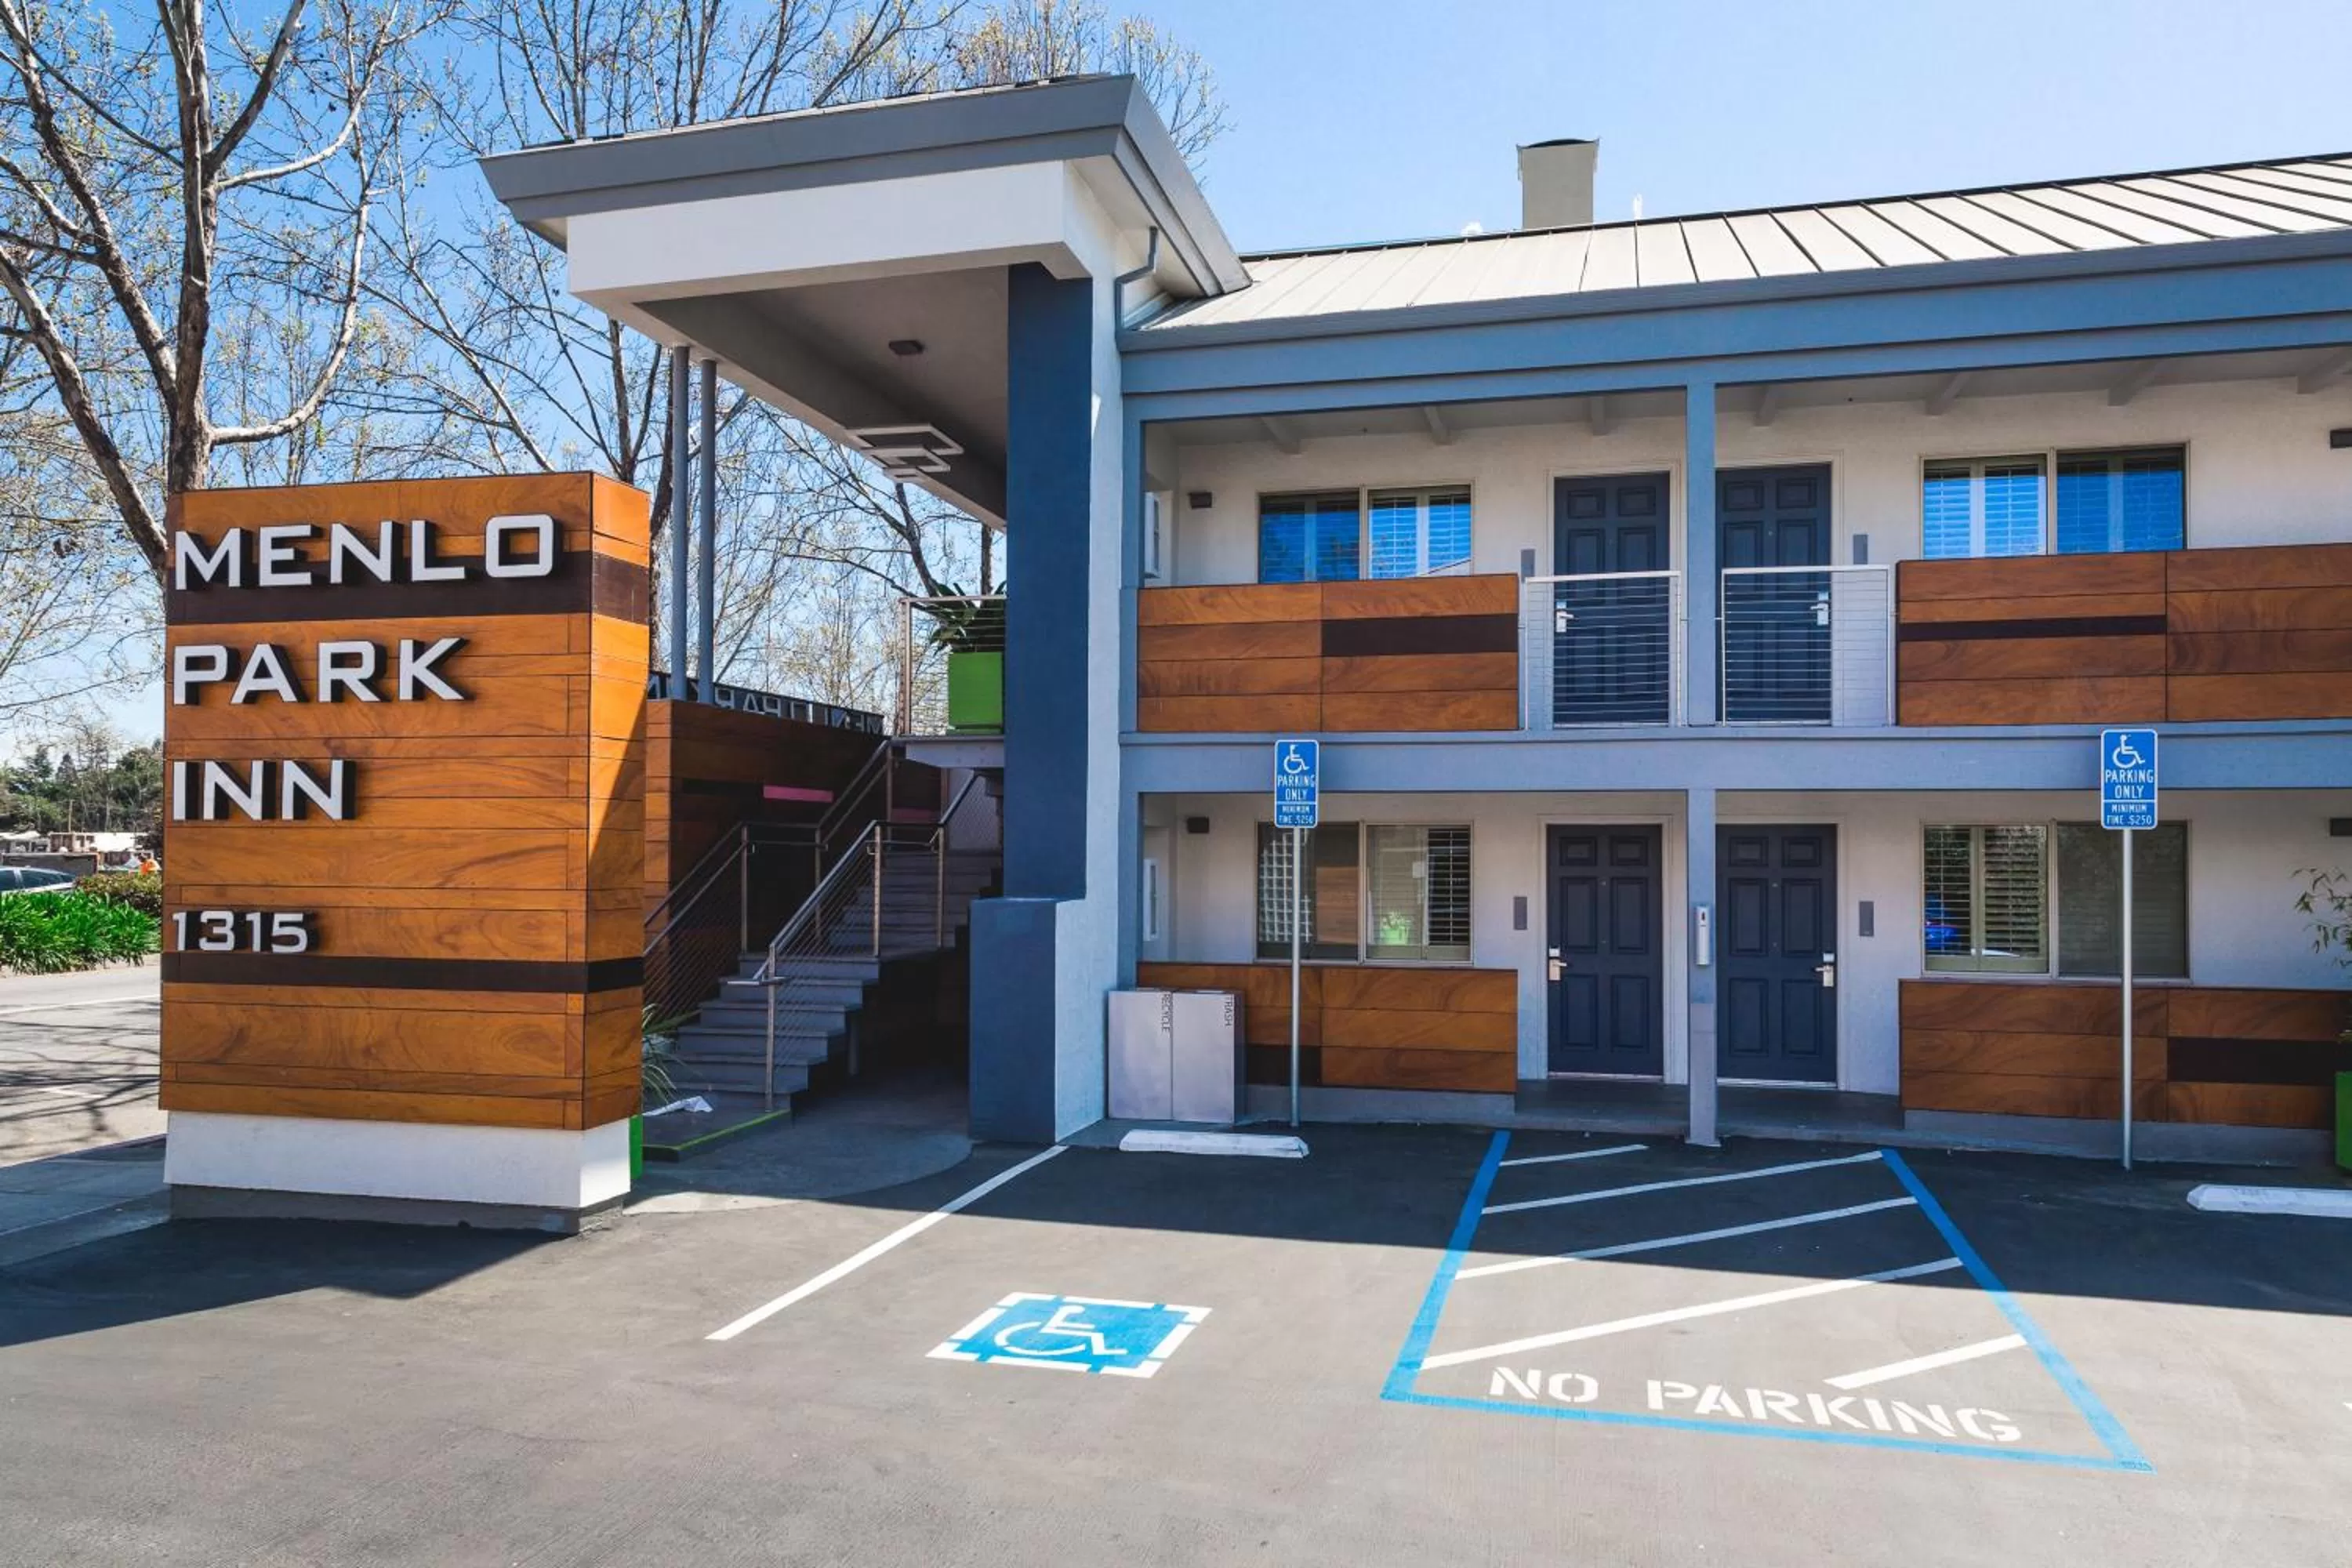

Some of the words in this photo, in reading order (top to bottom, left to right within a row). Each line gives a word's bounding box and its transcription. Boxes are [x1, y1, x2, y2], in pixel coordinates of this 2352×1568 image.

[174, 514, 556, 590] MENLO
[172, 637, 466, 706] PARK
[172, 759, 346, 821] INN
[1277, 774, 1316, 788] PARKING
[2105, 769, 2154, 783] PARKING
[1285, 788, 1308, 800] ONLY
[2114, 785, 2144, 799] ONLY
[2107, 815, 2124, 825] FINE
[2128, 815, 2152, 826] $250
[2111, 804, 2147, 813] MINIMUM
[172, 909, 310, 954] 1315
[1161, 993, 1171, 1033] RECYCLE
[1224, 996, 1233, 1026] TRASH
[1490, 1367, 1599, 1403] NO
[1647, 1379, 2022, 1442] PARKING
